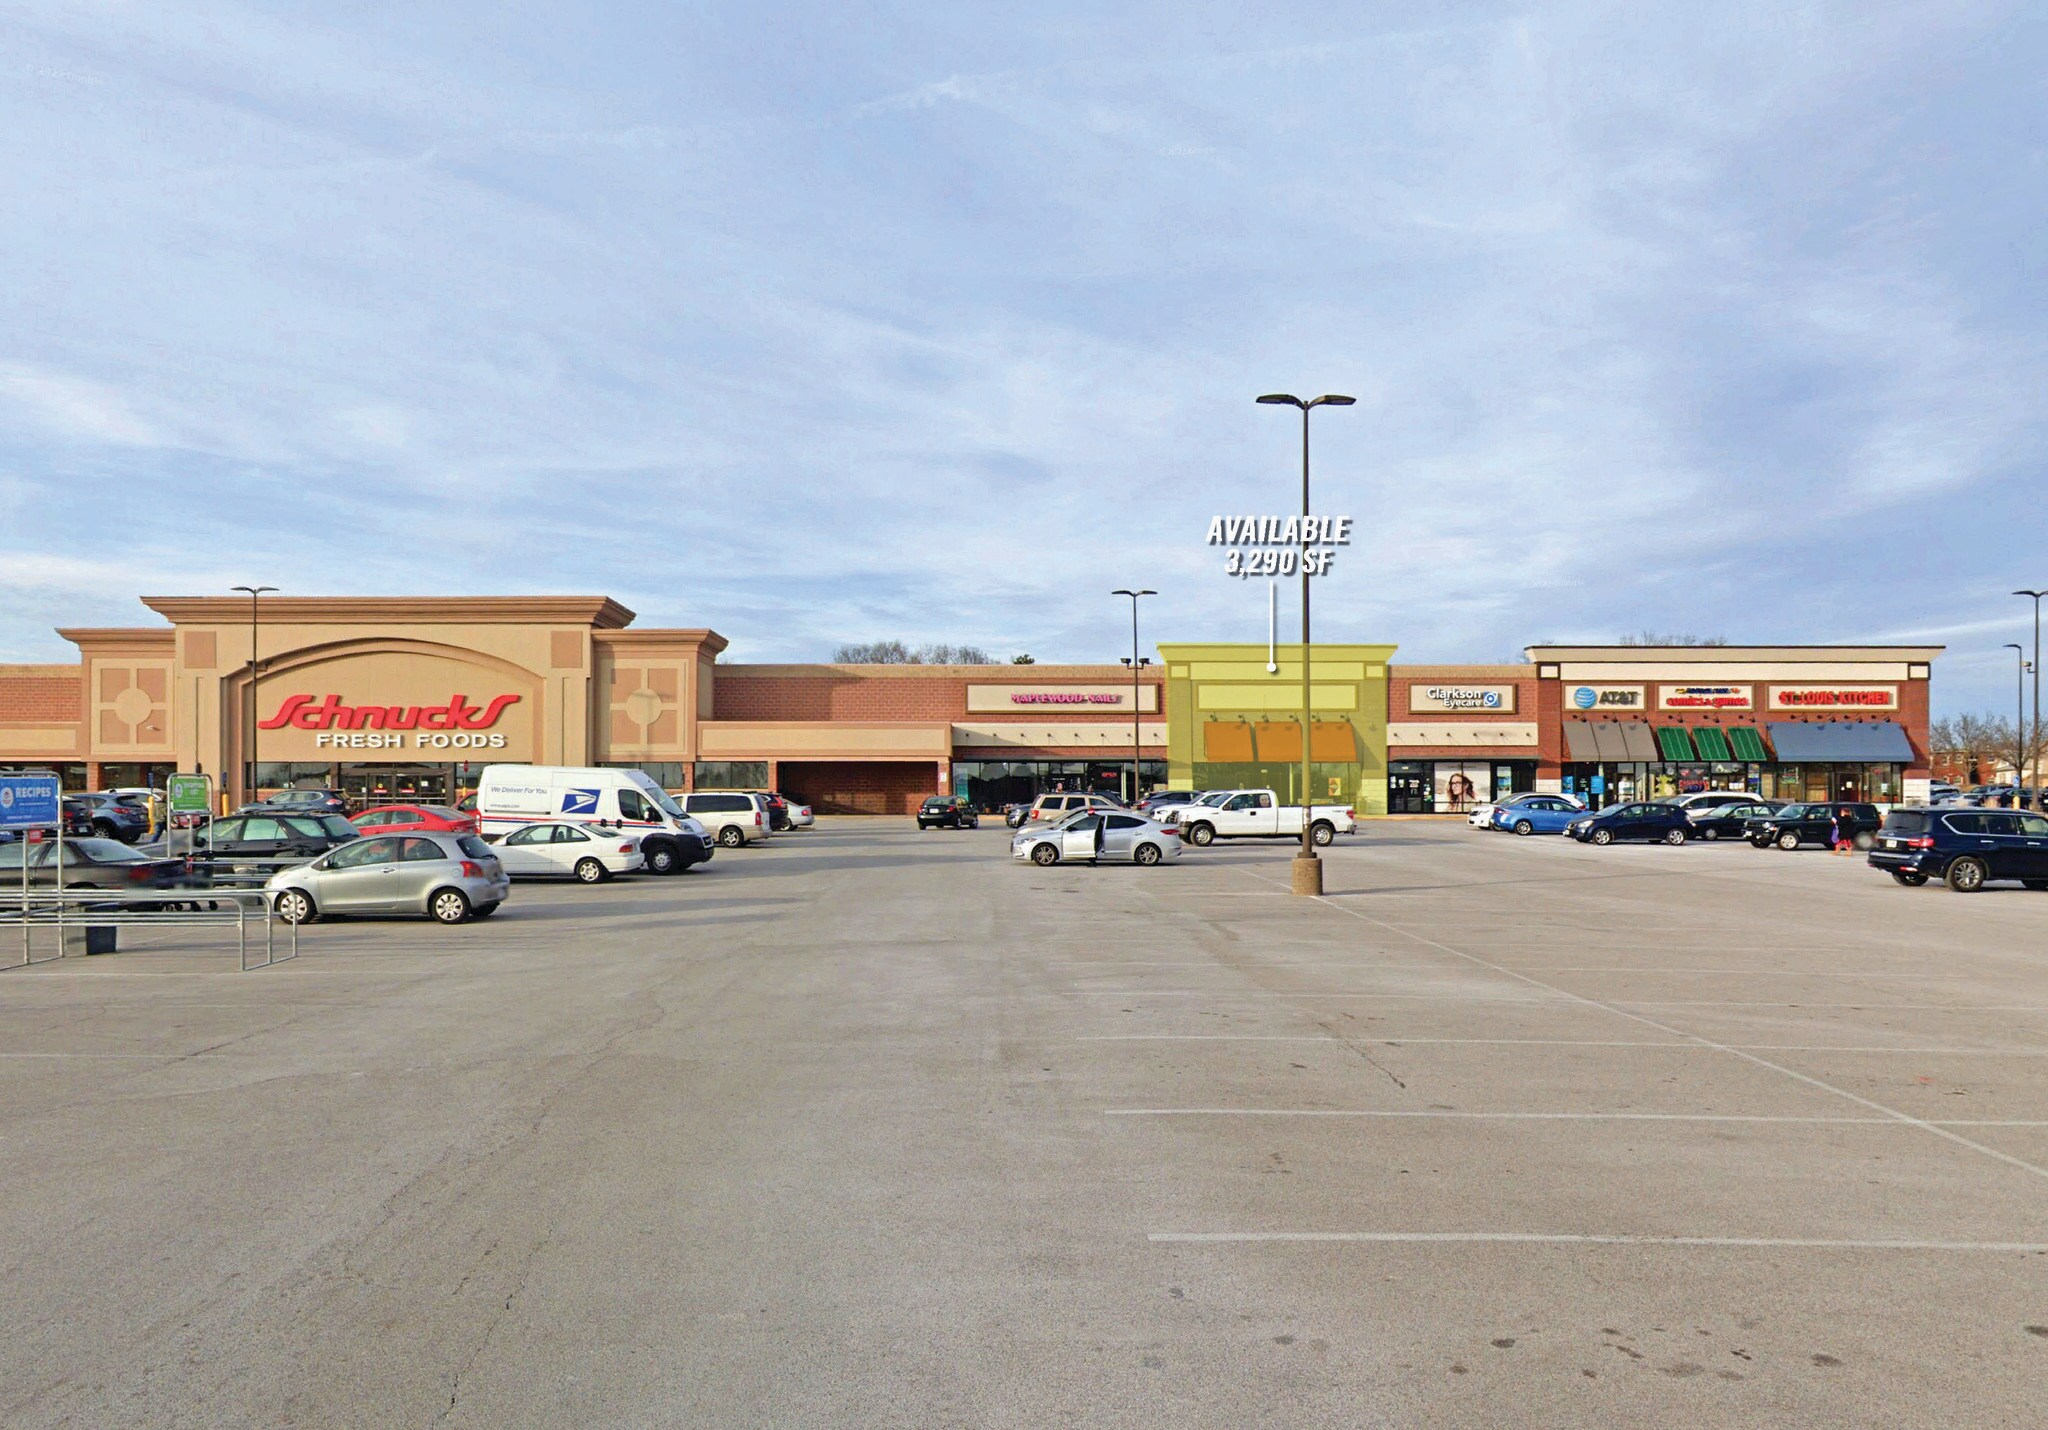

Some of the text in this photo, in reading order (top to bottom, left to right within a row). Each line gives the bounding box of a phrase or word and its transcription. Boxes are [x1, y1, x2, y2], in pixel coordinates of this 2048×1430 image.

[1011, 693, 1085, 704] MAPLEWOOD
[1427, 687, 1482, 699] Clarkson
[1599, 690, 1638, 705] AT&T
[1800, 691, 1835, 705] LOUIS
[1837, 691, 1890, 705] KITCHEN
[1443, 698, 1482, 709] Eyecare
[315, 733, 506, 748] FRESH FOODS
[15, 786, 52, 798] RECIPES
